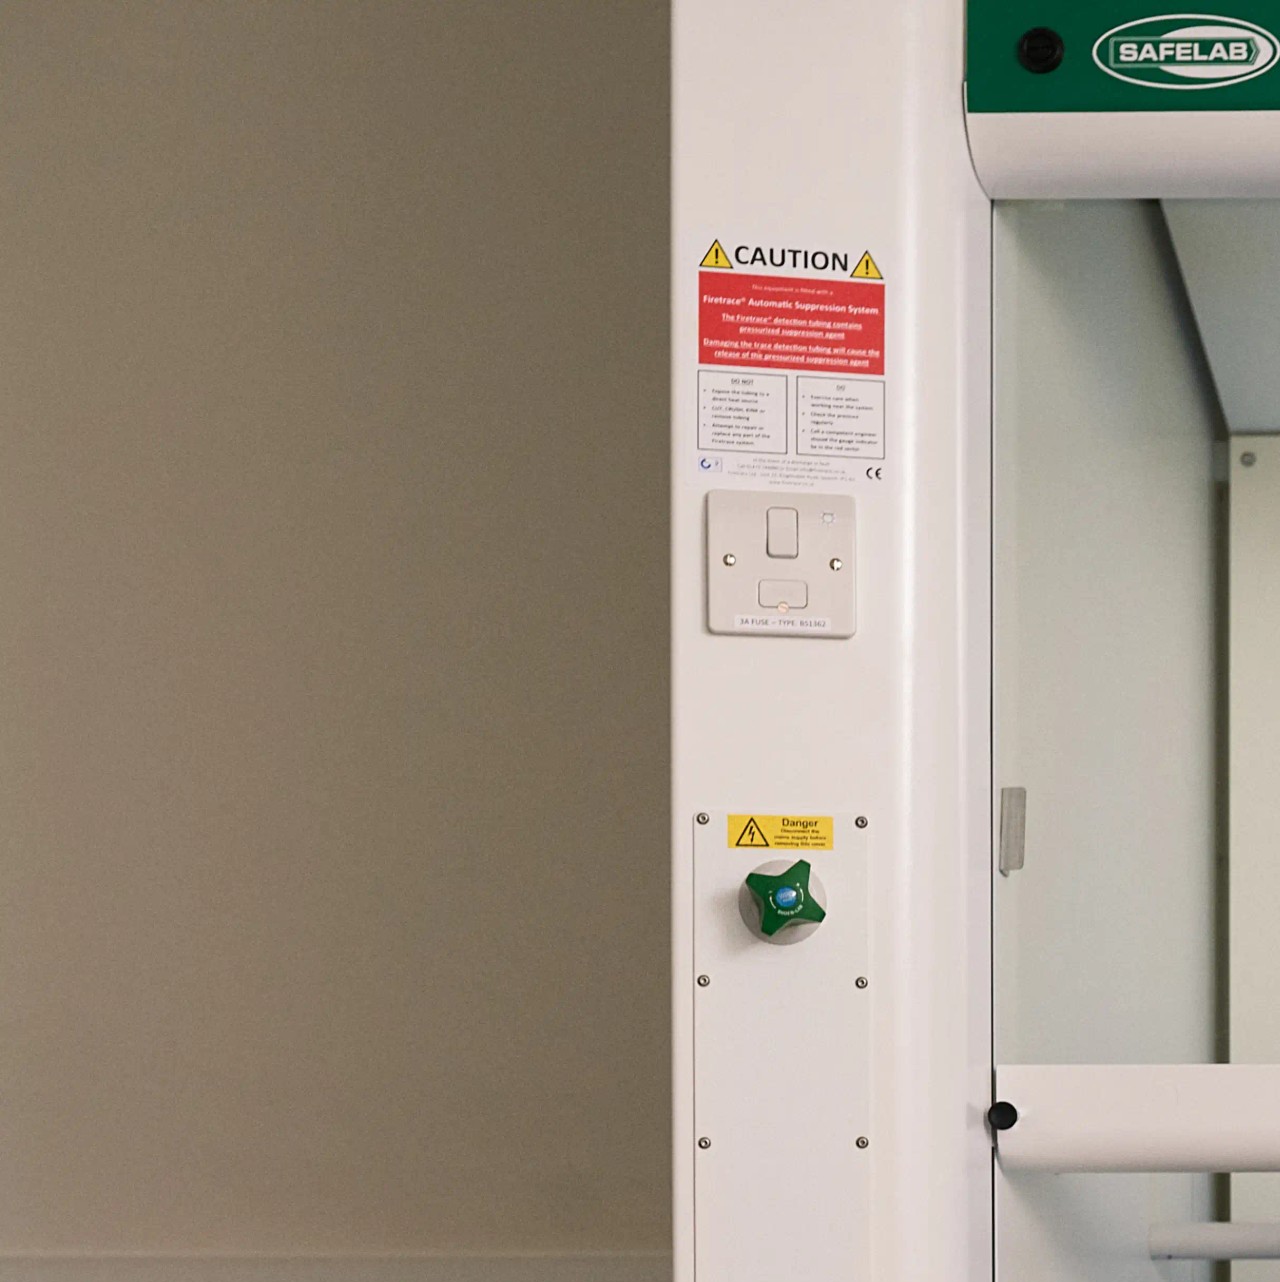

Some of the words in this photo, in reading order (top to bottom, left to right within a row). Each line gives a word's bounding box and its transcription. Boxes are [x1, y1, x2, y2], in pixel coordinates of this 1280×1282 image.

[1119, 42, 1248, 63] SAFELAB
[735, 246, 848, 271] CAUTION
[748, 298, 793, 309] Automatic
[794, 301, 846, 314] Suppression
[848, 304, 879, 315] System
[722, 313, 734, 321] The
[773, 317, 807, 326] detection
[809, 319, 832, 329] tubing
[832, 321, 862, 330] contains
[782, 329, 824, 338] suppression
[825, 332, 845, 340] agent
[704, 338, 739, 349] Damaging
[740, 340, 752, 348] the
[773, 342, 807, 352] detection
[809, 345, 831, 355] tubing
[714, 350, 740, 359] release
[806, 356, 848, 366] suppression
[849, 359, 869, 368] agent
[782, 818, 818, 829] Danger
